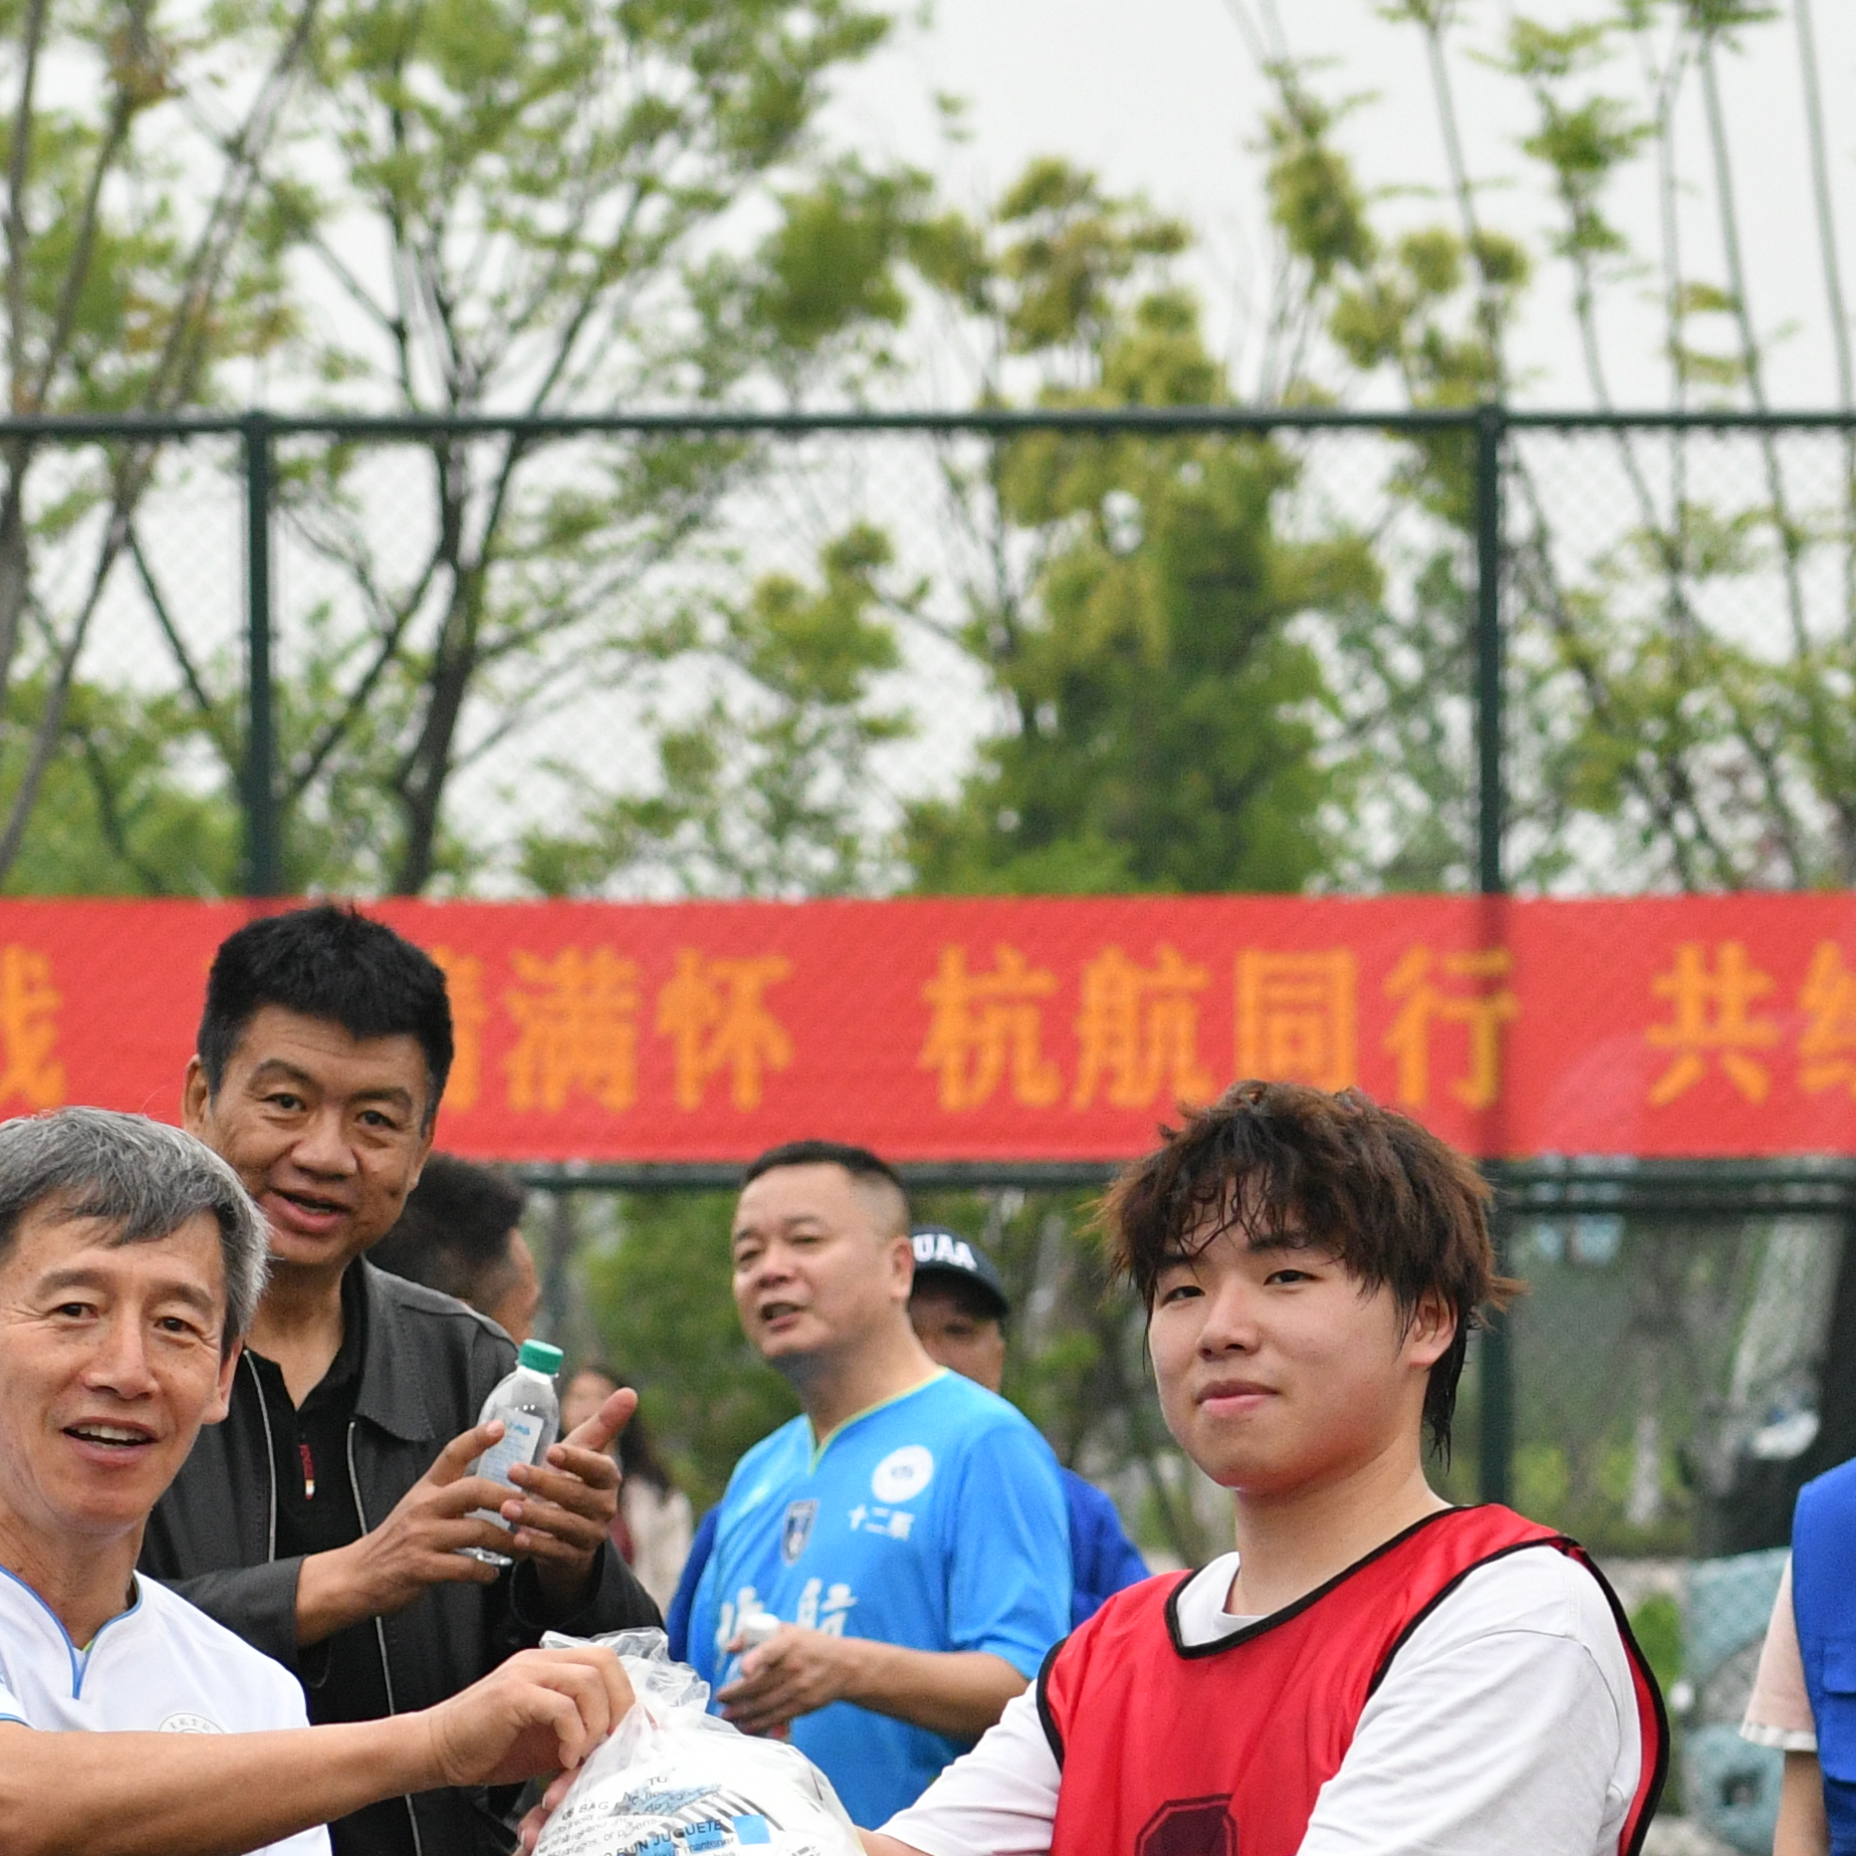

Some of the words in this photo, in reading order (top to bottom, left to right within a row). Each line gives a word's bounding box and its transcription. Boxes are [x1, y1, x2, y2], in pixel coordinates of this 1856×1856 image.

[922, 944, 1517, 1112] 杭航同行
[912, 1232, 978, 1272] UAA
[653, 1818, 723, 1848] JUGUETE
